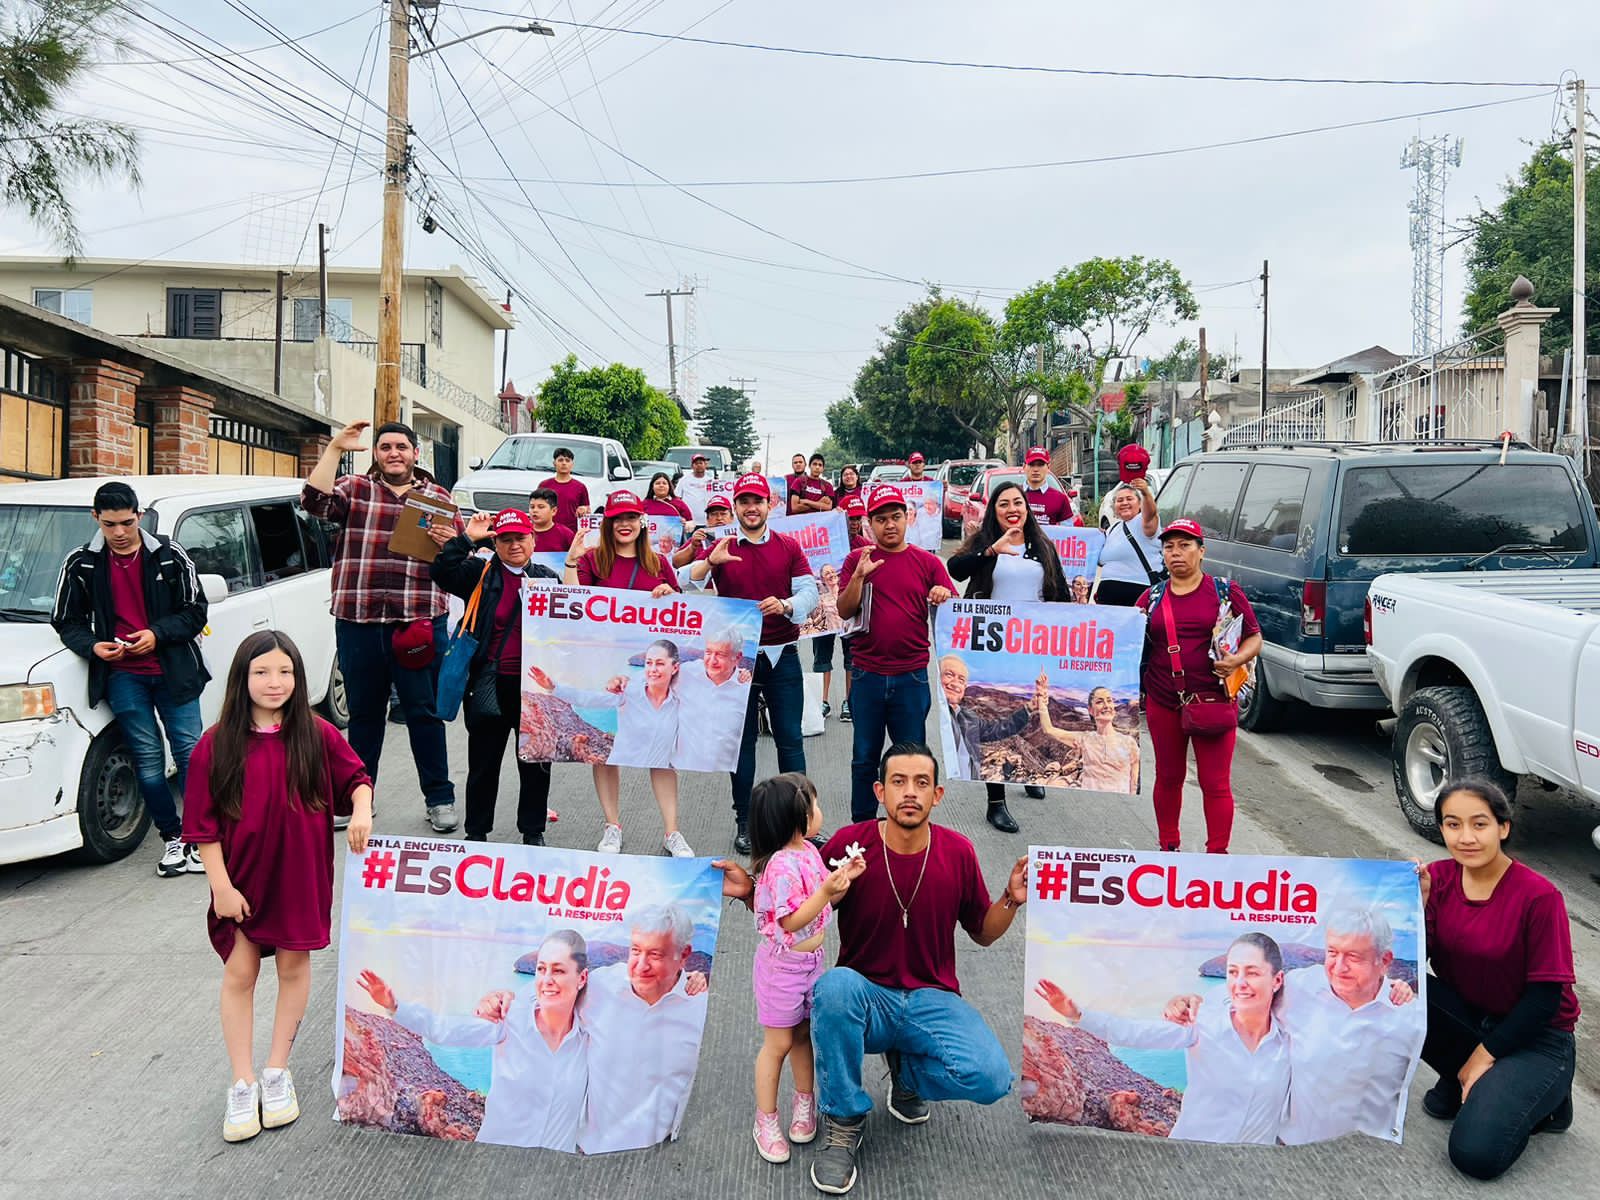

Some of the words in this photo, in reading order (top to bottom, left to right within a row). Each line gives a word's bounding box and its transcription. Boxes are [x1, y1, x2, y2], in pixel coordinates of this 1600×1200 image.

[552, 587, 591, 595] ENCUESTA
[528, 593, 703, 629] #EsClaudia
[952, 603, 962, 613] EN
[964, 603, 973, 614] LA
[975, 604, 1012, 616] ENCUESTA
[660, 627, 702, 636] RESPUESTA
[951, 615, 1114, 660] #EsClaudia
[1059, 659, 1068, 670] LA
[1070, 660, 1112, 673] RESPUESTA
[367, 839, 383, 848] EN
[386, 839, 401, 849] LA
[404, 841, 466, 854] ENCUESTA
[1037, 851, 1054, 859] EN
[1056, 852, 1072, 861] LA
[1074, 853, 1136, 863] ENCUESTA
[362, 850, 631, 911] #EsClaudia
[1036, 862, 1317, 913] #EsClaudia
[548, 907, 562, 917] LA
[565, 909, 623, 922] RESPUESTA
[1230, 912, 1246, 921] LA
[1249, 913, 1317, 925] RESPUESTA
